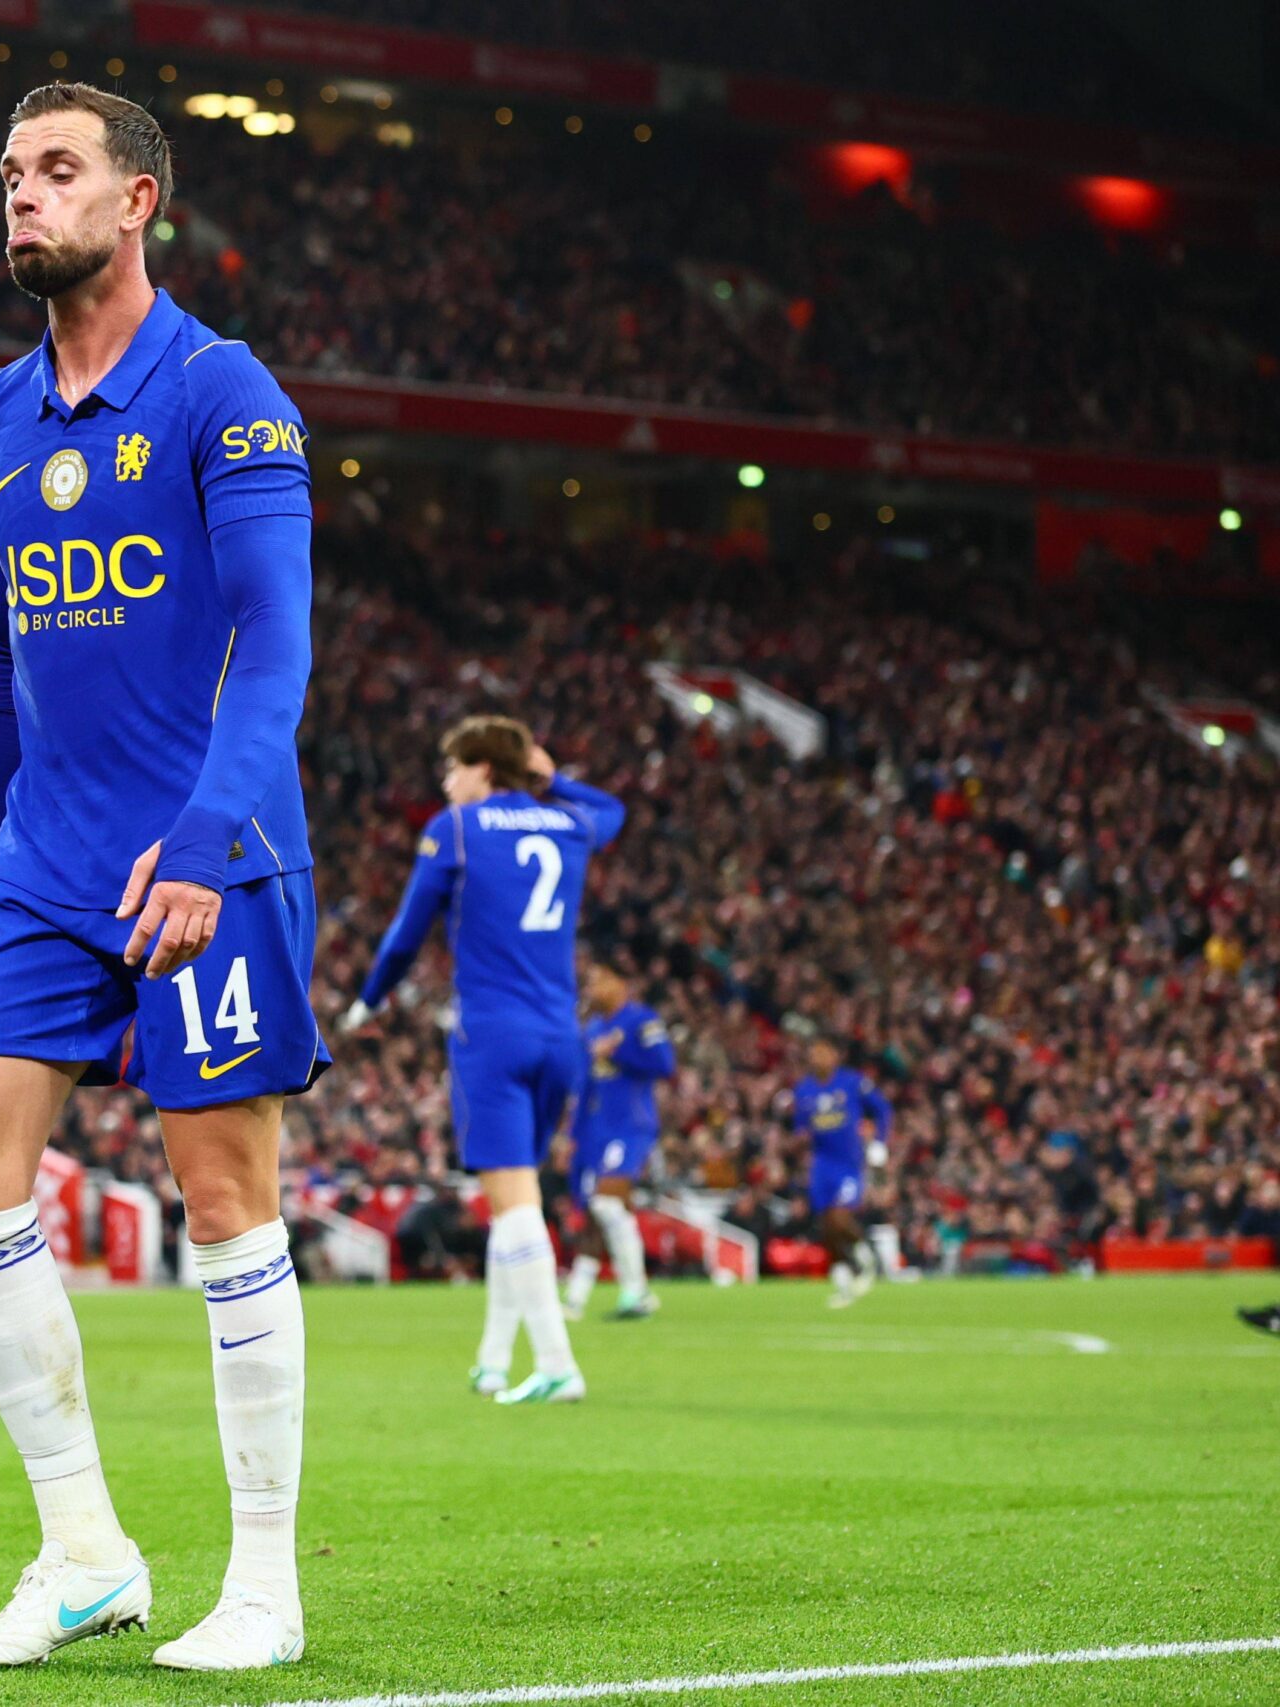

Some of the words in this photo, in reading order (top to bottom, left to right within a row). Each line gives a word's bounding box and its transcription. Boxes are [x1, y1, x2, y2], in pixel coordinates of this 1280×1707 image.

[53, 495, 72, 506] FIFA
[32, 613, 52, 631] BY
[56, 606, 126, 629] CIRCLE
[515, 834, 565, 932] 2
[171, 956, 261, 1054] 14
